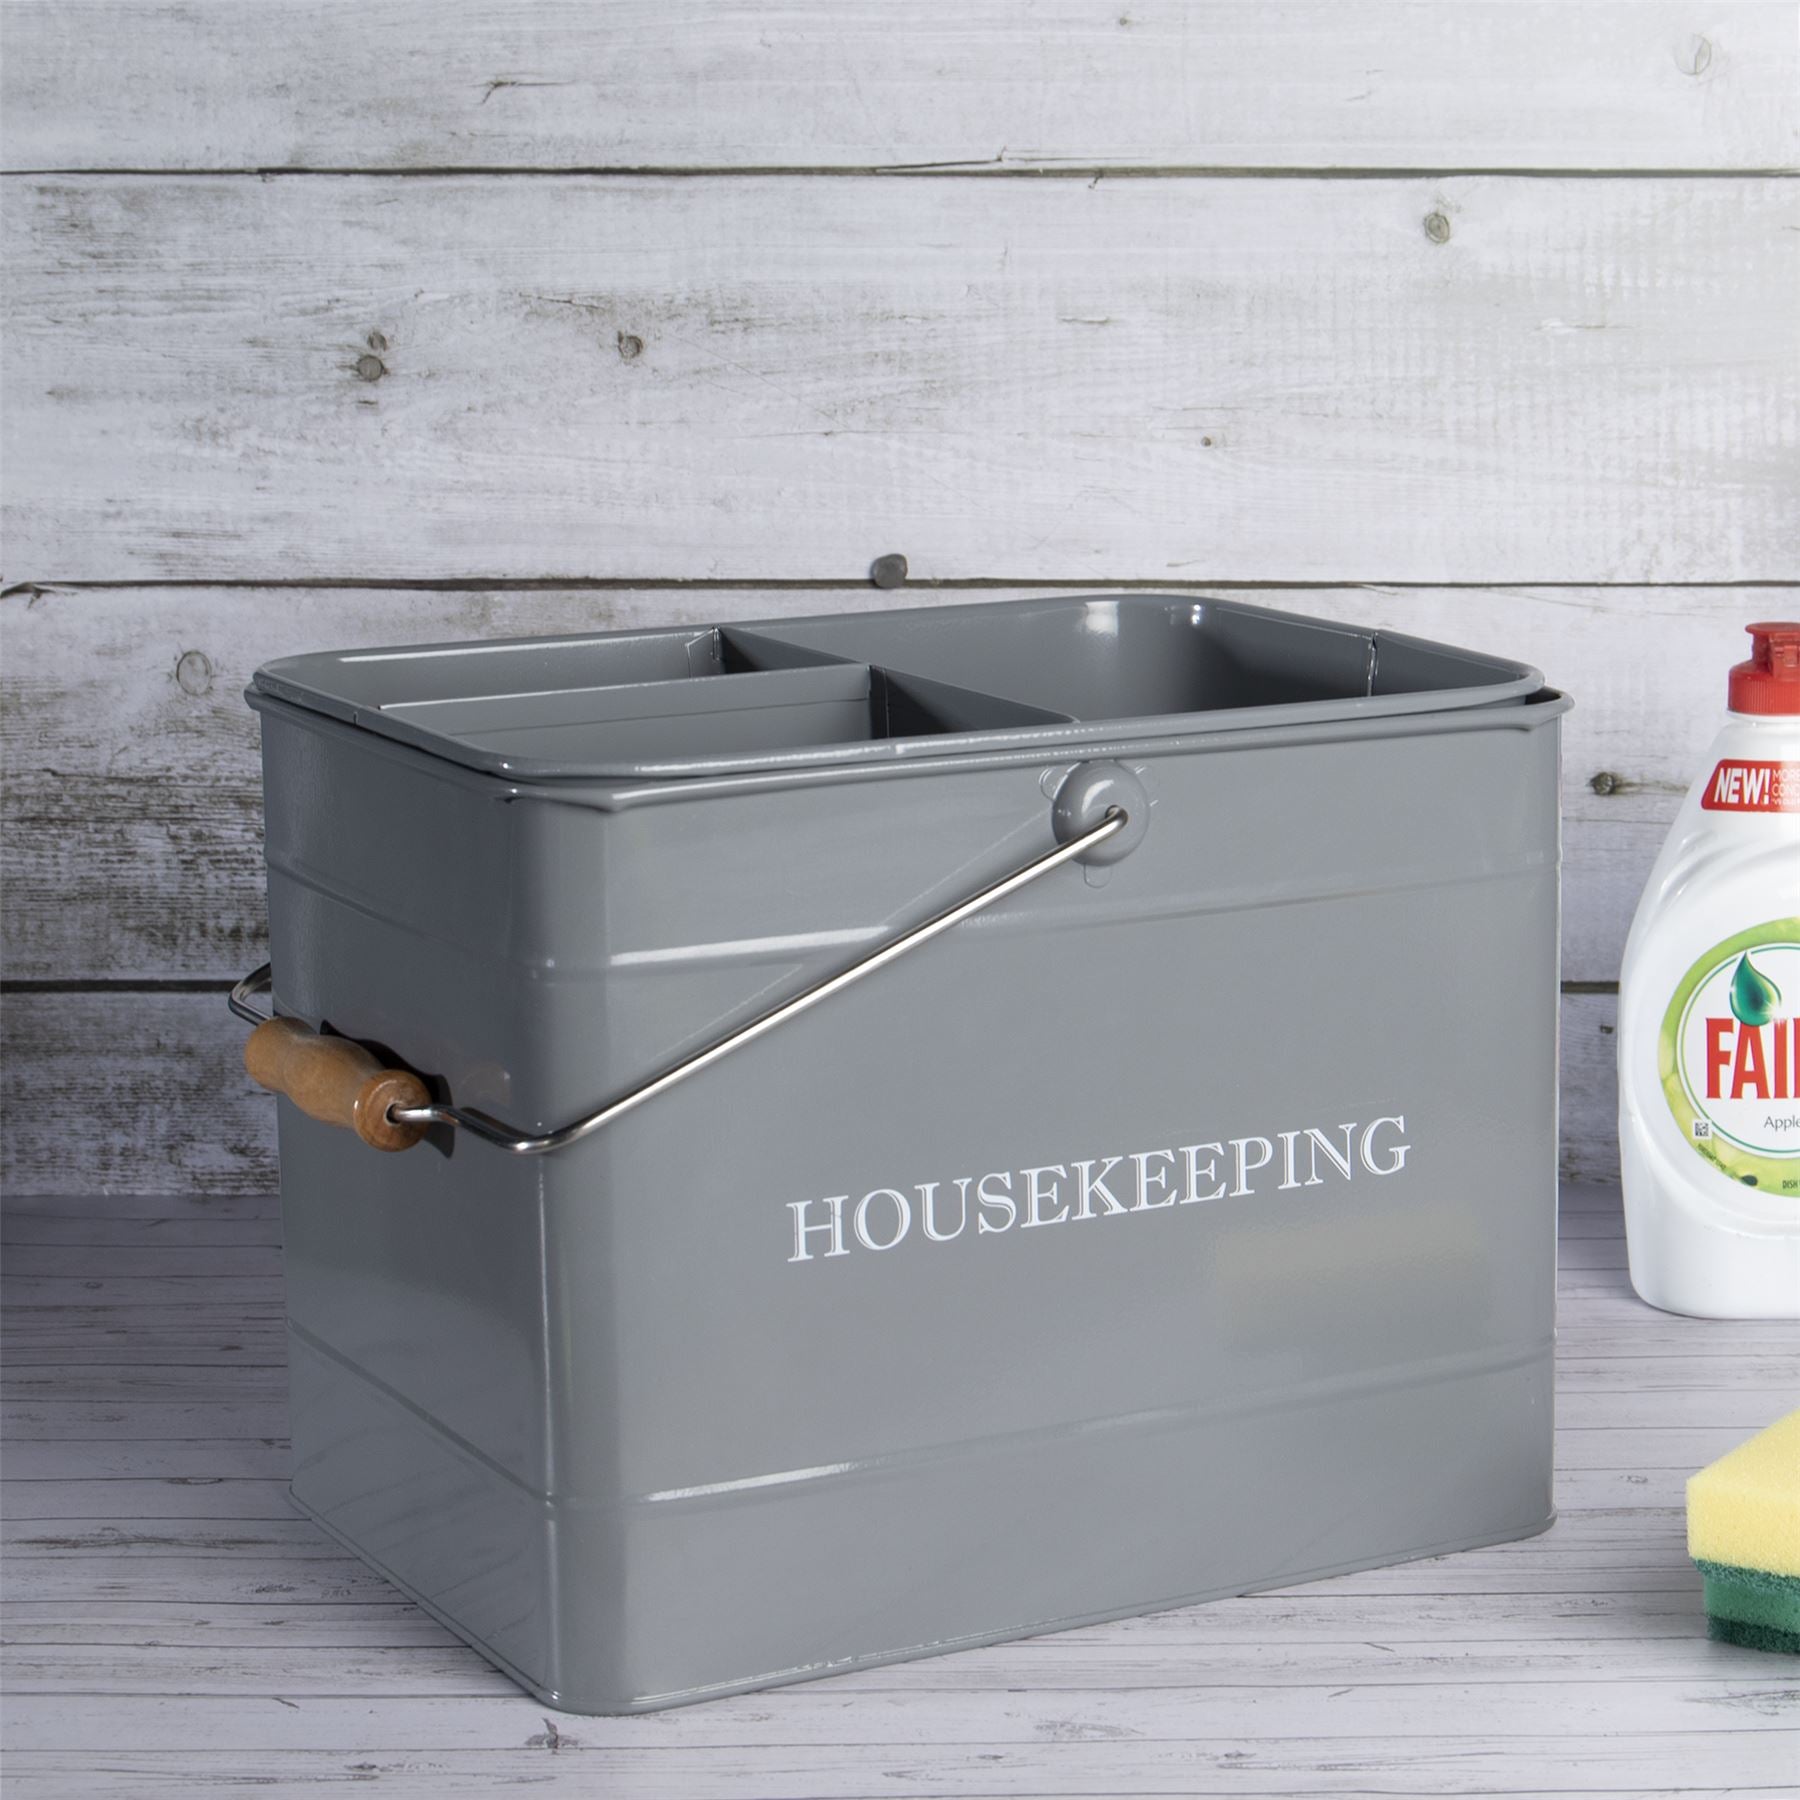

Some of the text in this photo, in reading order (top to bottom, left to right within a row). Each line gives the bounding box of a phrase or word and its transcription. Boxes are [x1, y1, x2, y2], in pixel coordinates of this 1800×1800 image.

[1713, 767, 1771, 805] NEW!
[1705, 1017, 1800, 1099] FAI
[786, 1115, 1412, 1263] HOUSEKEEPING
